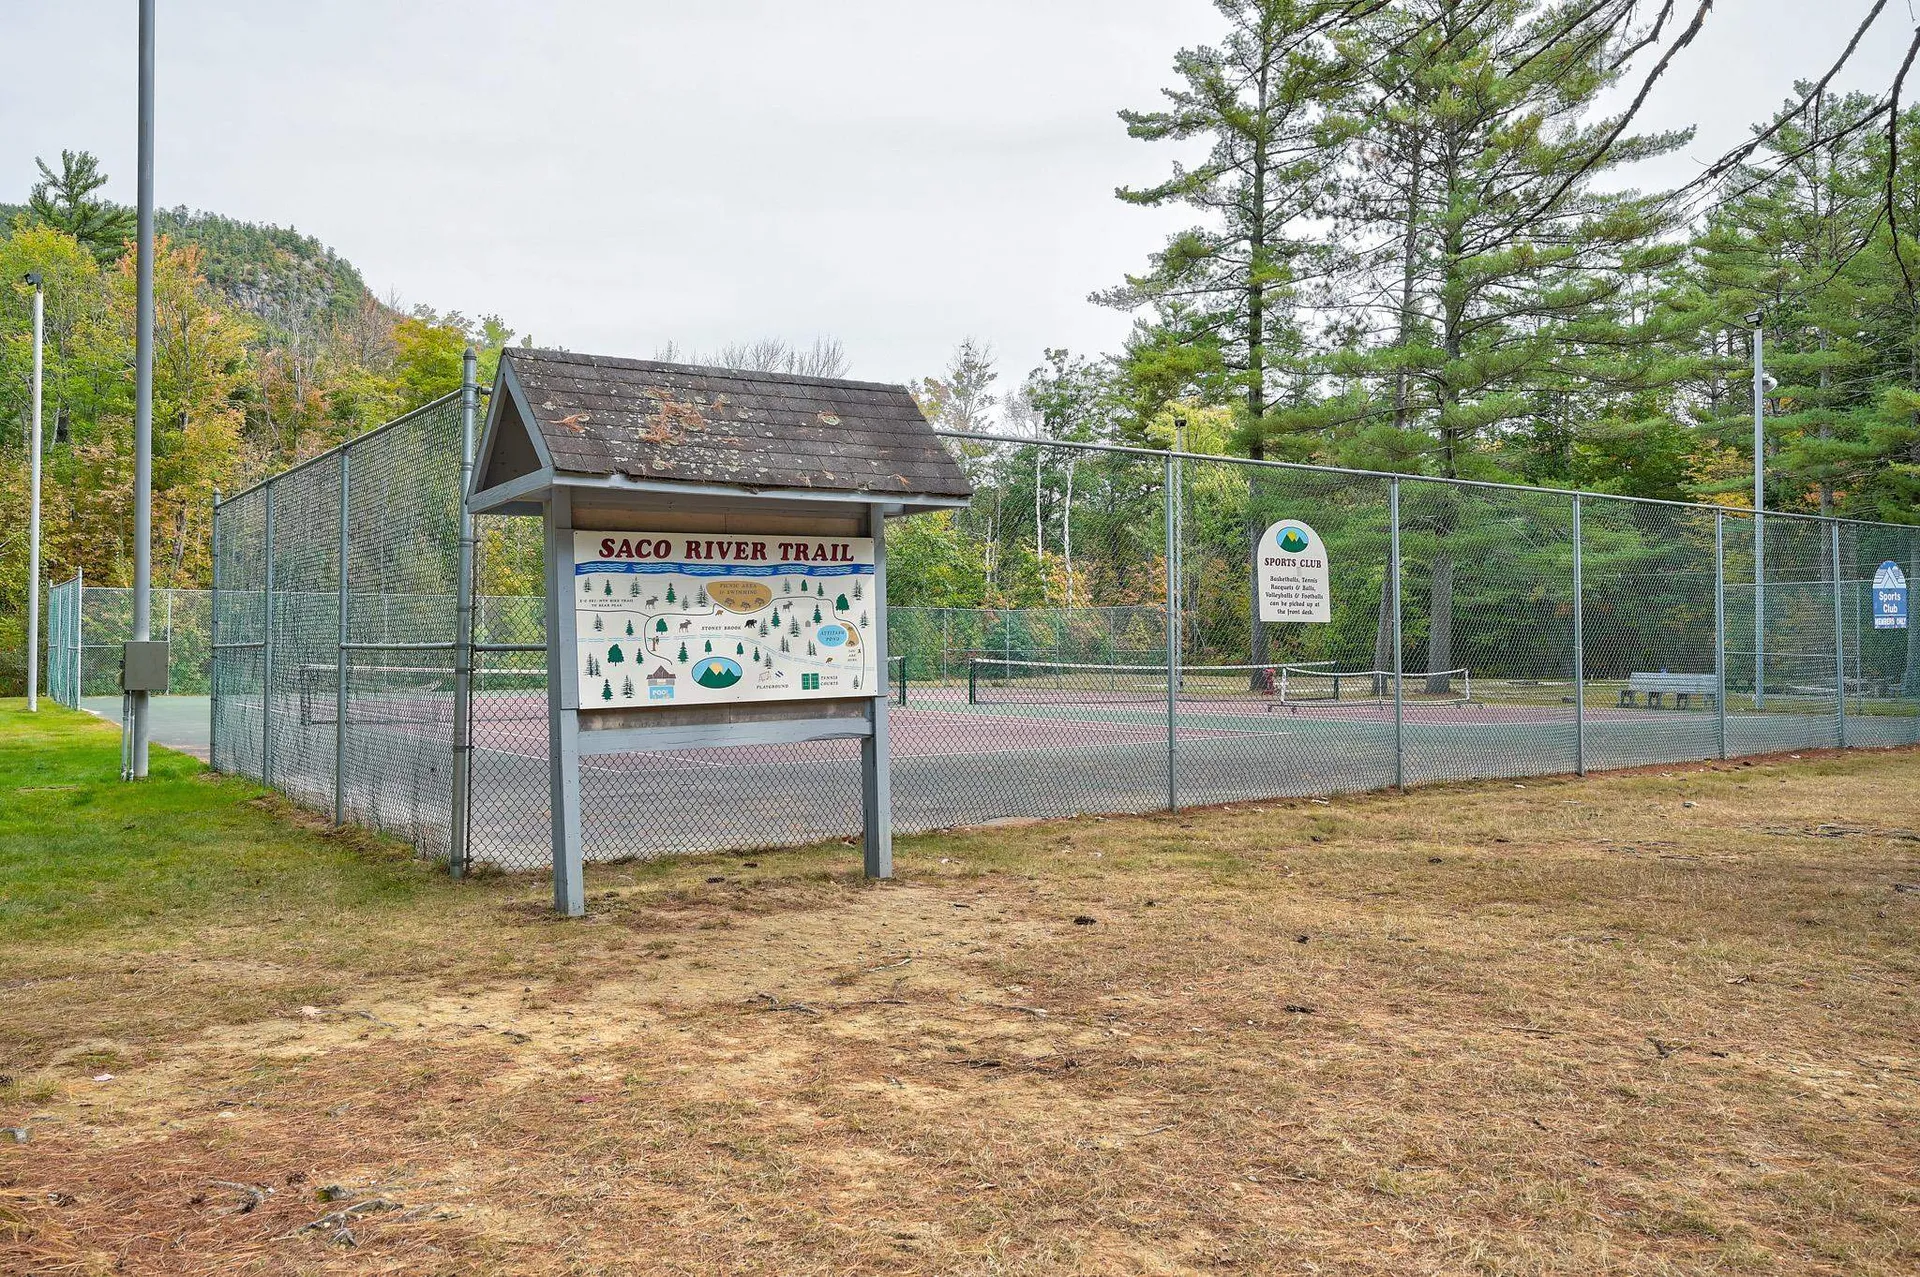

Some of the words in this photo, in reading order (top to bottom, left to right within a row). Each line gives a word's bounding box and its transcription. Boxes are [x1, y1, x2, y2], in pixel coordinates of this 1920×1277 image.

[599, 538, 672, 559] SACO
[685, 540, 767, 560] RIVER
[778, 543, 854, 562] TRAIL
[1264, 557, 1297, 567] SPORTS
[1299, 559, 1322, 568] CLUB
[1879, 591, 1901, 602] Sports
[1287, 608, 1300, 616] front
[1883, 603, 1898, 613] Club
[1874, 617, 1895, 625] MEMBERS
[1896, 617, 1907, 625] ONLY
